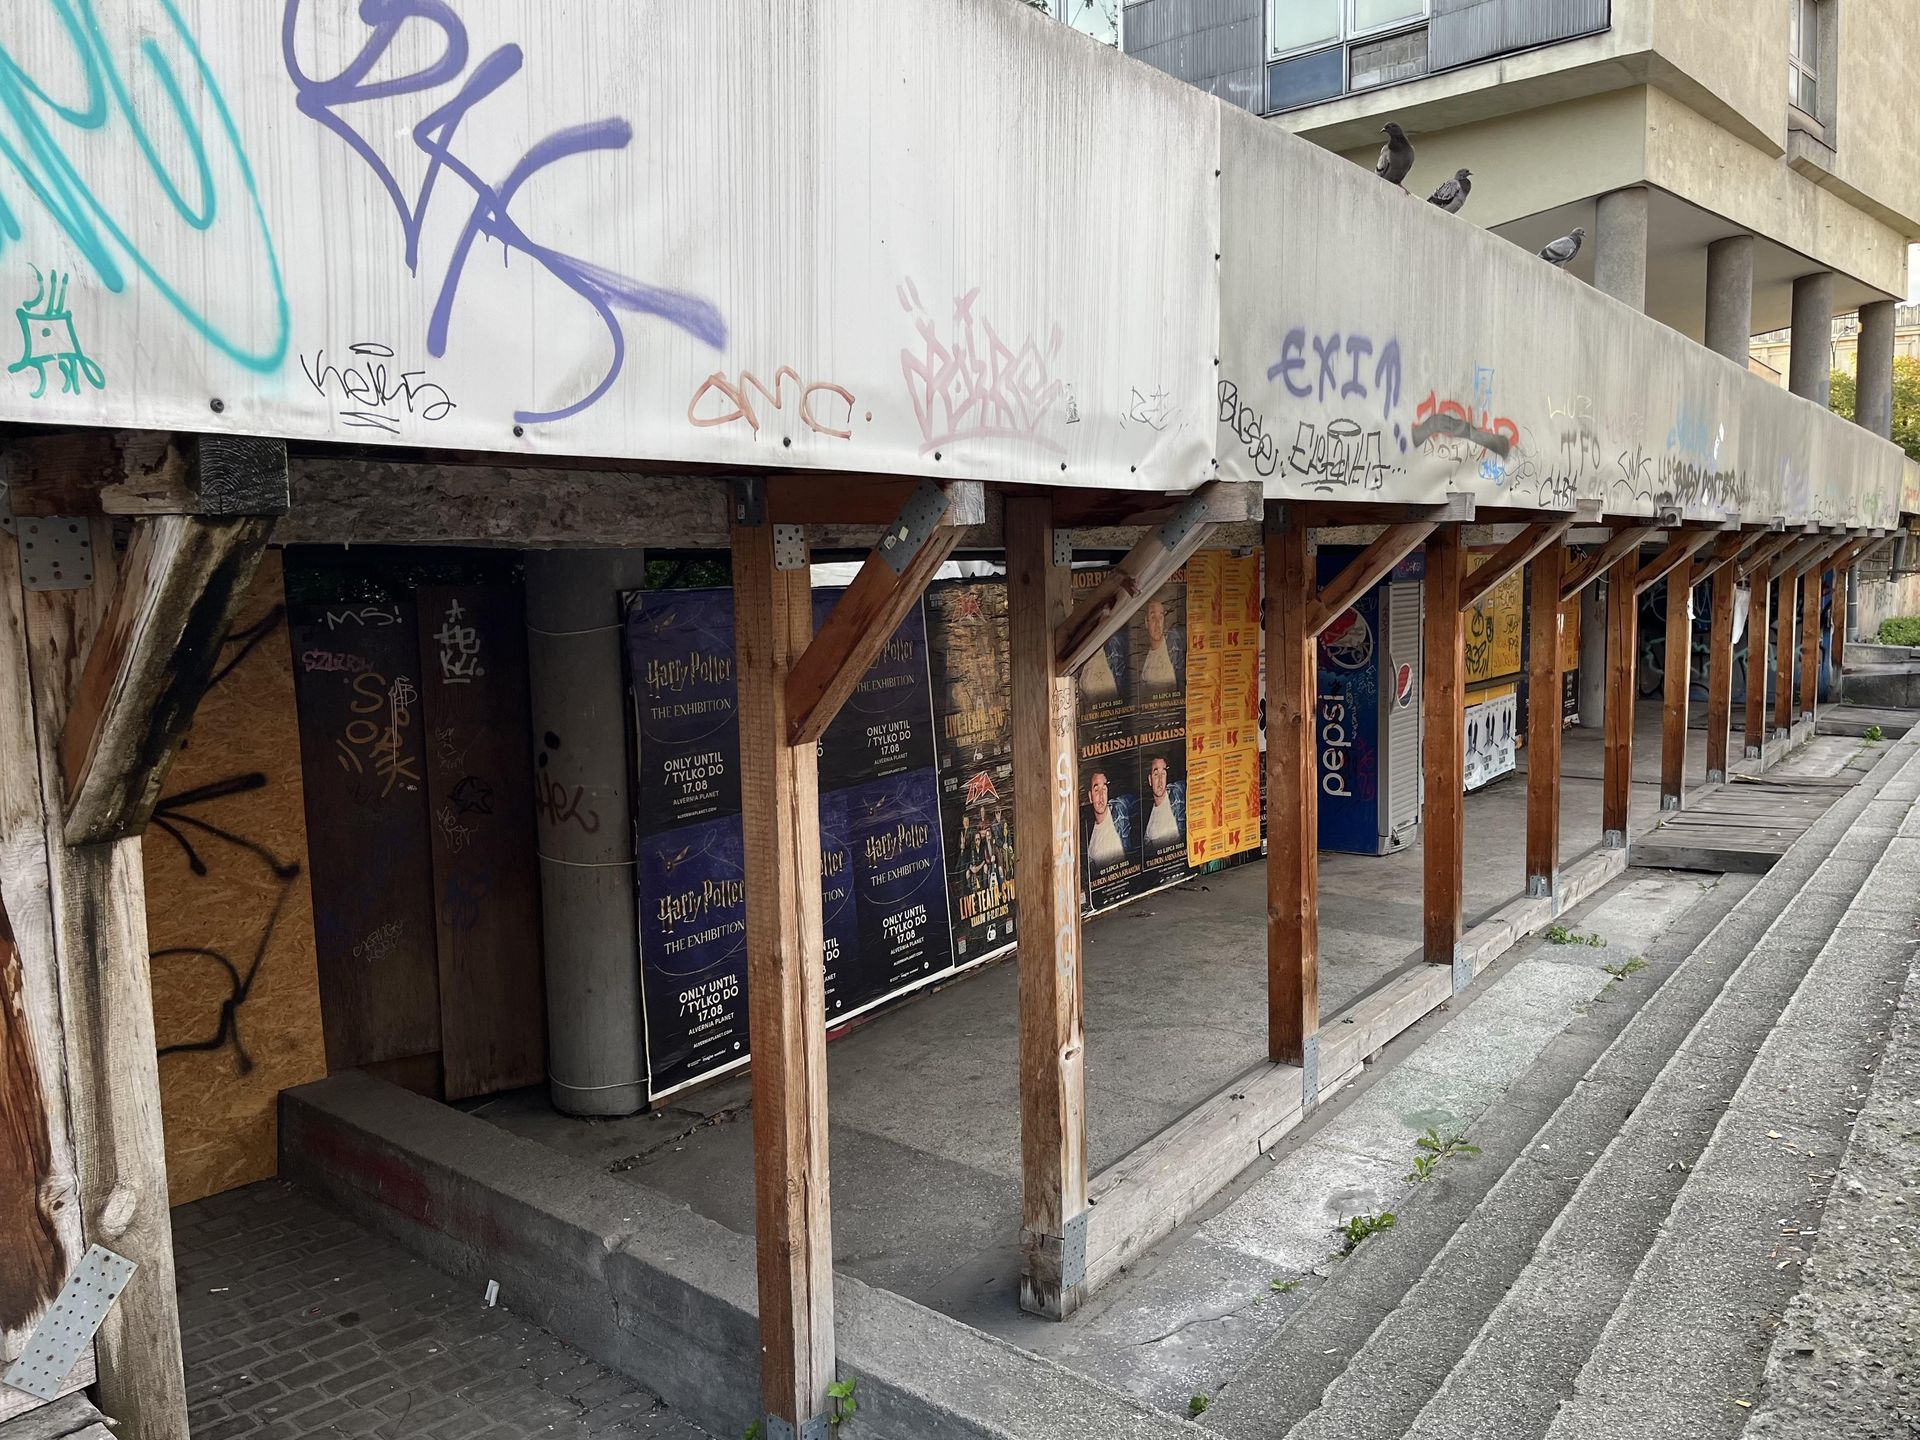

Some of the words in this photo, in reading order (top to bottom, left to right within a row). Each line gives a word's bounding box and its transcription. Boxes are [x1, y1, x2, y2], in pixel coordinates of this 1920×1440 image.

[645, 660, 688, 693] Harry
[690, 651, 732, 687] Potter
[856, 681, 871, 693] THE
[872, 675, 915, 691] EXHIBITION
[651, 706, 672, 720] THE
[674, 699, 732, 717] EXHIBITION
[866, 725, 888, 737] ONLY
[889, 720, 911, 732] UNTIL
[873, 734, 897, 747] TYLKO
[899, 730, 911, 741] DO
[881, 745, 900, 756] 17.08
[1318, 694, 1352, 797] pepsi
[663, 756, 692, 773] ONLY
[693, 752, 724, 766] UNTIL
[672, 768, 706, 784] TYLKO
[709, 765, 724, 776] DO
[673, 795, 698, 806] ALVERNIA
[699, 790, 719, 801] PLANET
[682, 781, 708, 794] 17.08
[865, 833, 899, 863] Harry
[899, 824, 929, 850] Potter
[1163, 844, 1175, 854] LIPCA
[871, 874, 887, 887] THE
[887, 859, 930, 880] EXHIBITION
[1106, 863, 1120, 874] LIPCA
[657, 892, 701, 927] Harry
[702, 880, 745, 913] Potter
[959, 893, 977, 920] LIVE
[882, 914, 903, 928] ONLY
[904, 905, 926, 919] UNTIL
[889, 921, 914, 937] TYLKO
[915, 915, 927, 926] DO
[664, 941, 686, 955] THE
[687, 919, 745, 947] EXHIBITION
[890, 944, 909, 955] ALVERNIA
[909, 937, 924, 949] PLANET
[896, 931, 916, 944] 17.08
[826, 950, 840, 962] DO
[679, 985, 707, 1004] ONLY
[709, 974, 738, 993] UNTIL
[687, 995, 720, 1015] TYLKO
[723, 987, 739, 1002] DO
[697, 1005, 723, 1022] 17.08
[688, 1022, 714, 1036] ALVERNIA
[714, 1013, 734, 1027] PLANET
